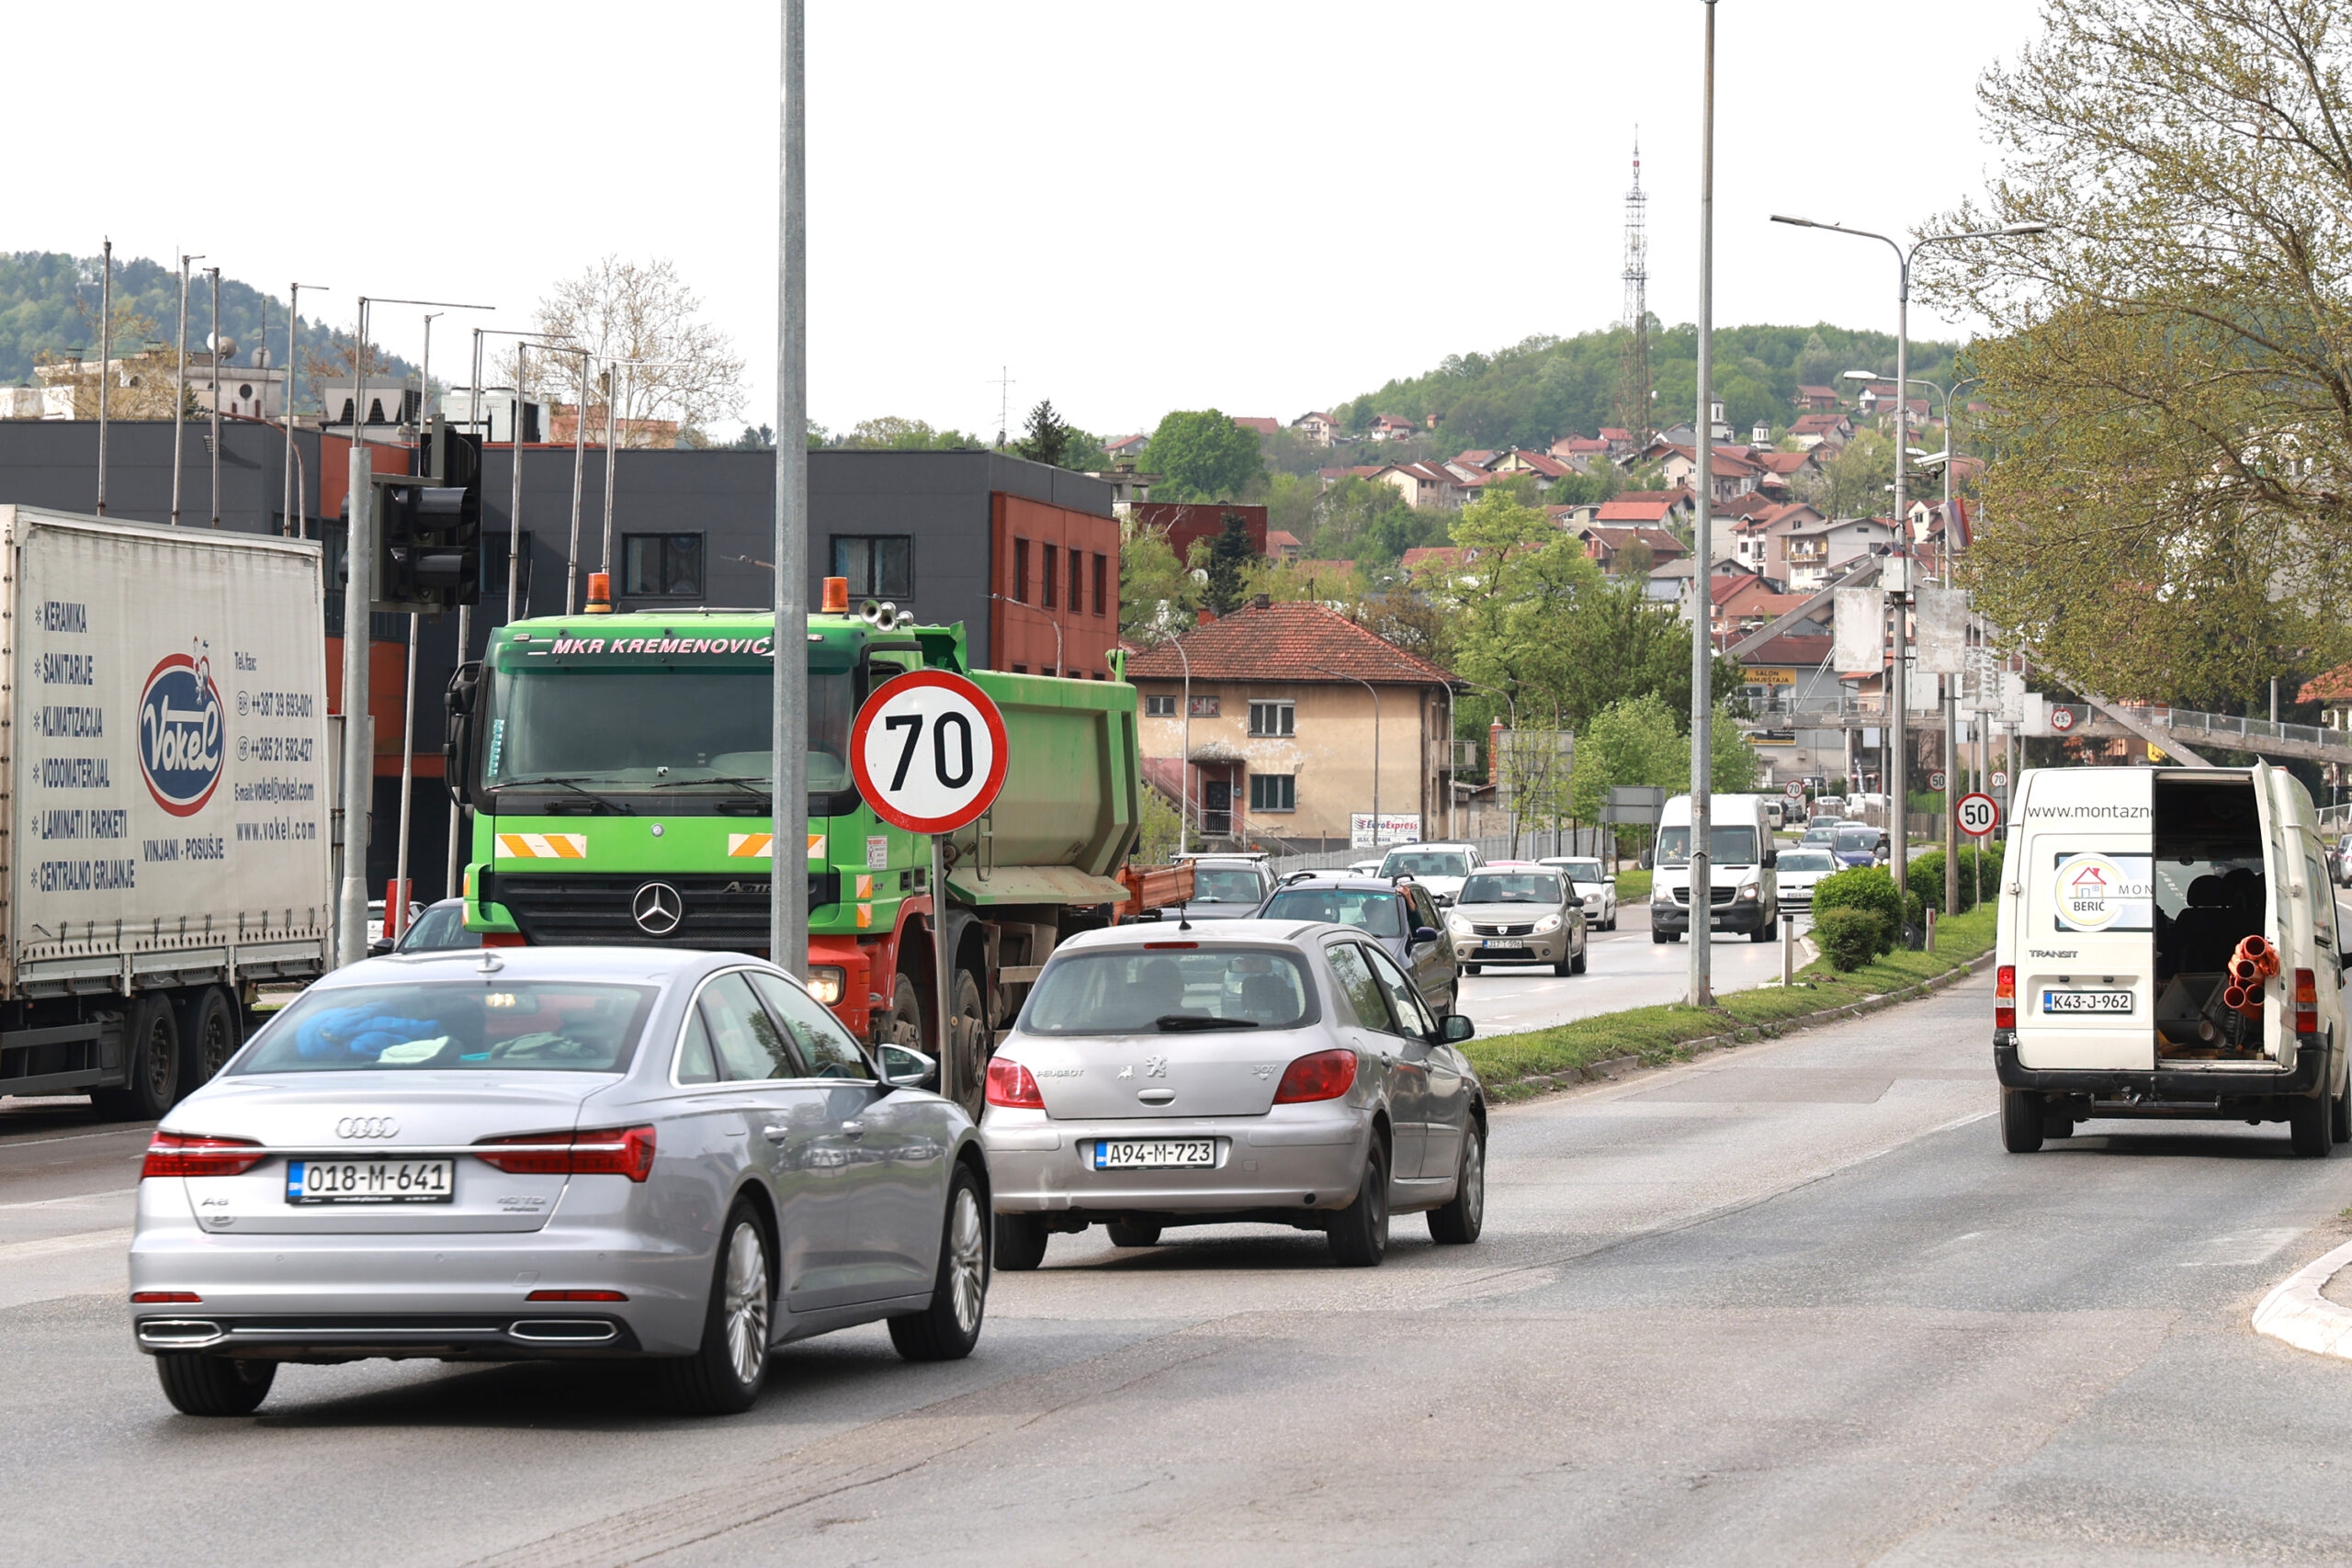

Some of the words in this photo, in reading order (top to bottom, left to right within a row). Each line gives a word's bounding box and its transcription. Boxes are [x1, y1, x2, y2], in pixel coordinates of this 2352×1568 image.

[44, 601, 87, 633] KERAMIKA
[551, 638, 605, 654] MKR
[610, 637, 771, 654] KREMENOVIĆ
[43, 653, 94, 685] SANITARIJE
[275, 694, 285, 716] 39
[286, 694, 313, 717] 693-001
[42, 705, 103, 738] KLIMATIZACIJA
[274, 738, 283, 761] 21
[285, 738, 313, 761] 582-427
[885, 712, 974, 792] 70
[41, 758, 109, 788] VODOMATERIJAL
[1932, 775, 1945, 787] 50
[1994, 775, 2005, 784] 70
[1789, 784, 1801, 795] 70
[41, 810, 84, 840] LAMINATI
[91, 809, 128, 838] PARKETI
[1964, 804, 1989, 825] 50
[236, 816, 316, 841] www.vokel.com
[143, 840, 179, 862] VINJANI
[186, 833, 224, 860] POSUŠJE
[40, 860, 91, 892] CENTRALNO
[94, 859, 135, 889] GRIJANJE
[2074, 898, 2106, 911] BERIĆ
[2029, 950, 2078, 958] TRANSIT
[2053, 995, 2129, 1010] K43-J-962
[1036, 1069, 1085, 1077] PEUGEOT
[1250, 1065, 1278, 1075] 307
[1110, 1143, 1211, 1164] A94-M-723
[308, 1164, 445, 1191] 018-M-641
